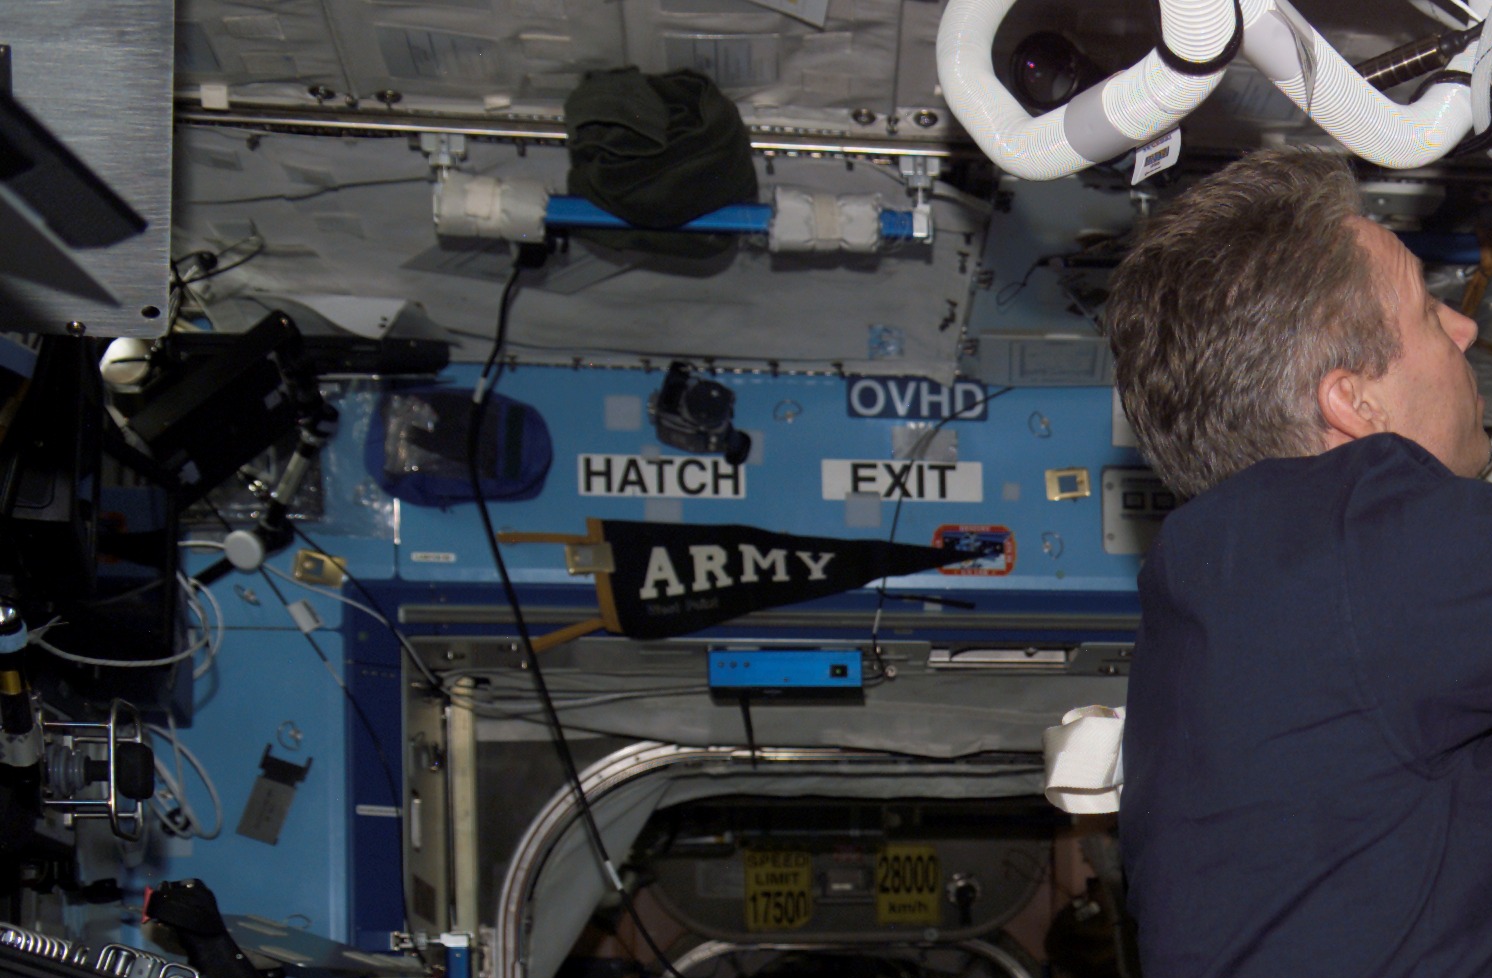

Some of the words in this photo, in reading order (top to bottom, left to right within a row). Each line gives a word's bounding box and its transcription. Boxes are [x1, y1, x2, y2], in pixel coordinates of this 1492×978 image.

[850, 378, 986, 420] OVHD
[583, 456, 740, 497] HATCH
[850, 462, 957, 499] EXIT
[639, 544, 835, 600] ARMY
[748, 853, 809, 868] SPEED
[755, 872, 799, 887] LIMIT
[879, 855, 937, 894] 28000
[750, 890, 808, 925] 17500
